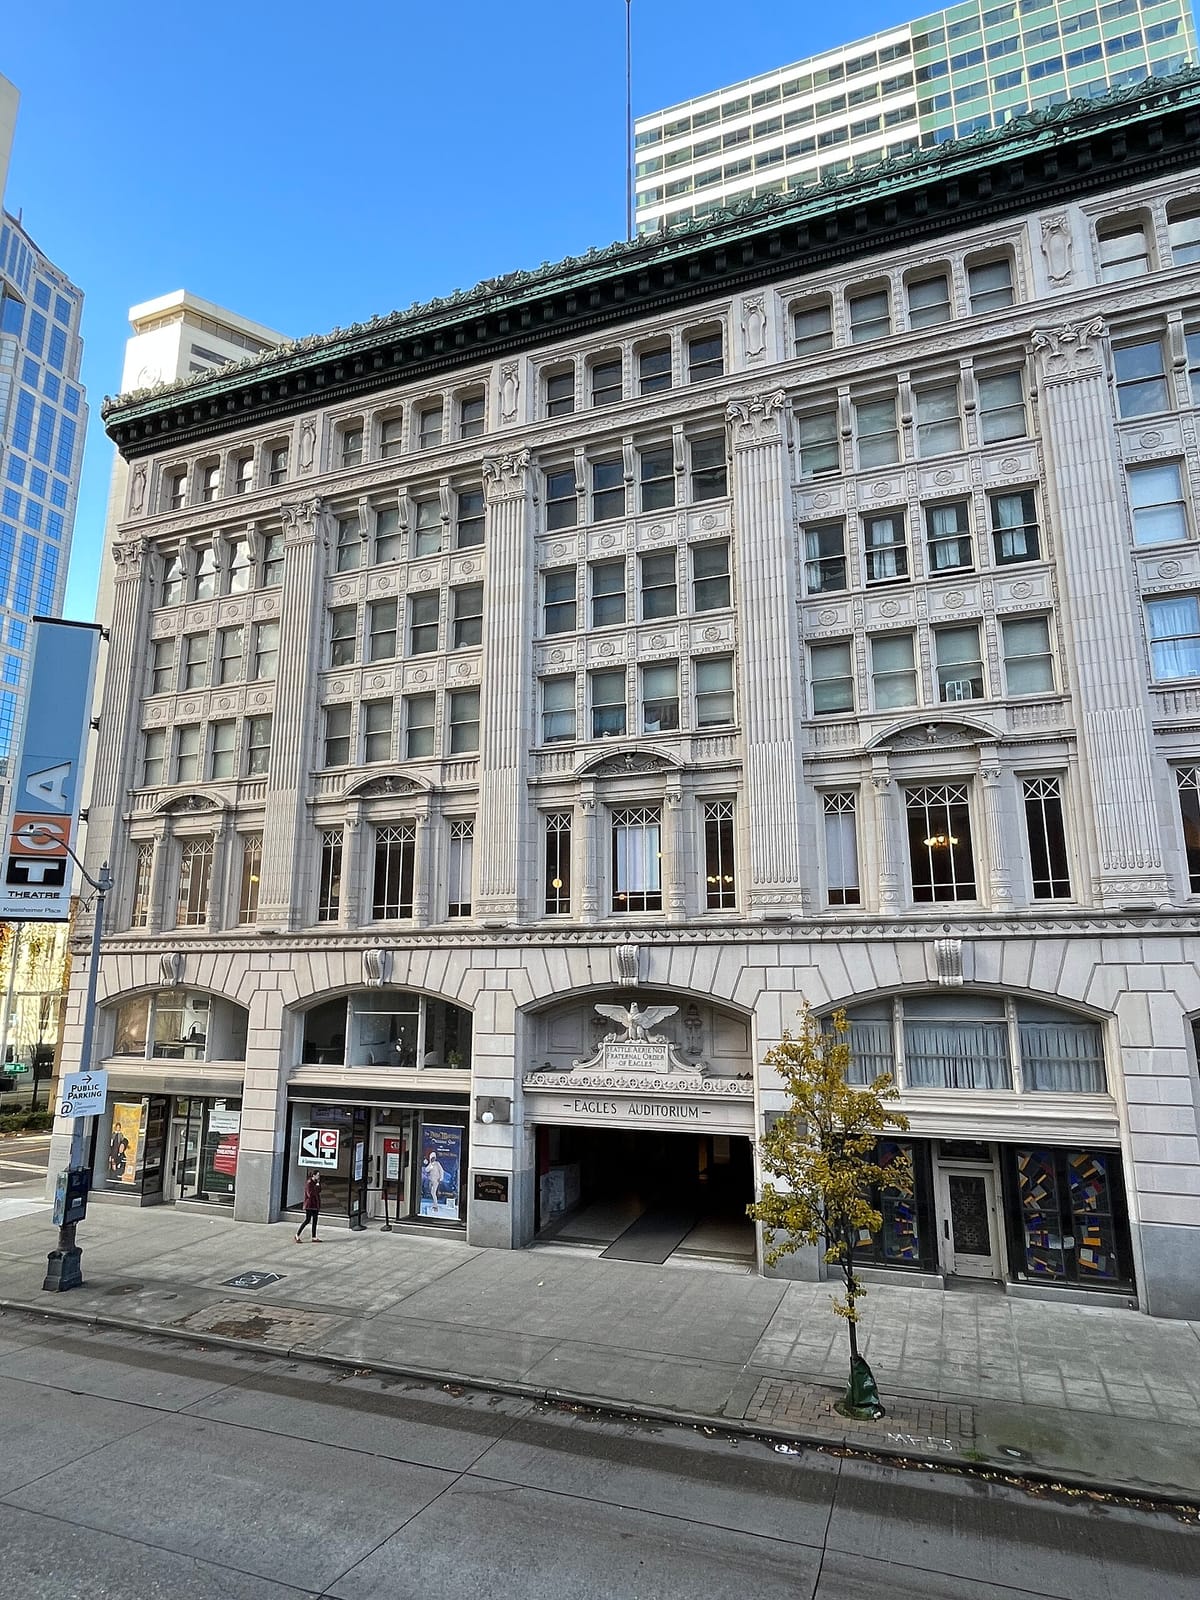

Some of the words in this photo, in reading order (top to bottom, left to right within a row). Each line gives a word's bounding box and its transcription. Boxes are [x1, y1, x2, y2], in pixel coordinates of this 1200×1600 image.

[8, 891, 61, 899] THEATRE
[642, 1053, 665, 1061] ORDER
[71, 1084, 100, 1092] PUBLIC
[67, 1091, 102, 1100] PARKING
[574, 1100, 617, 1114] EAGLES
[628, 1103, 699, 1118] AUDITORIUM
